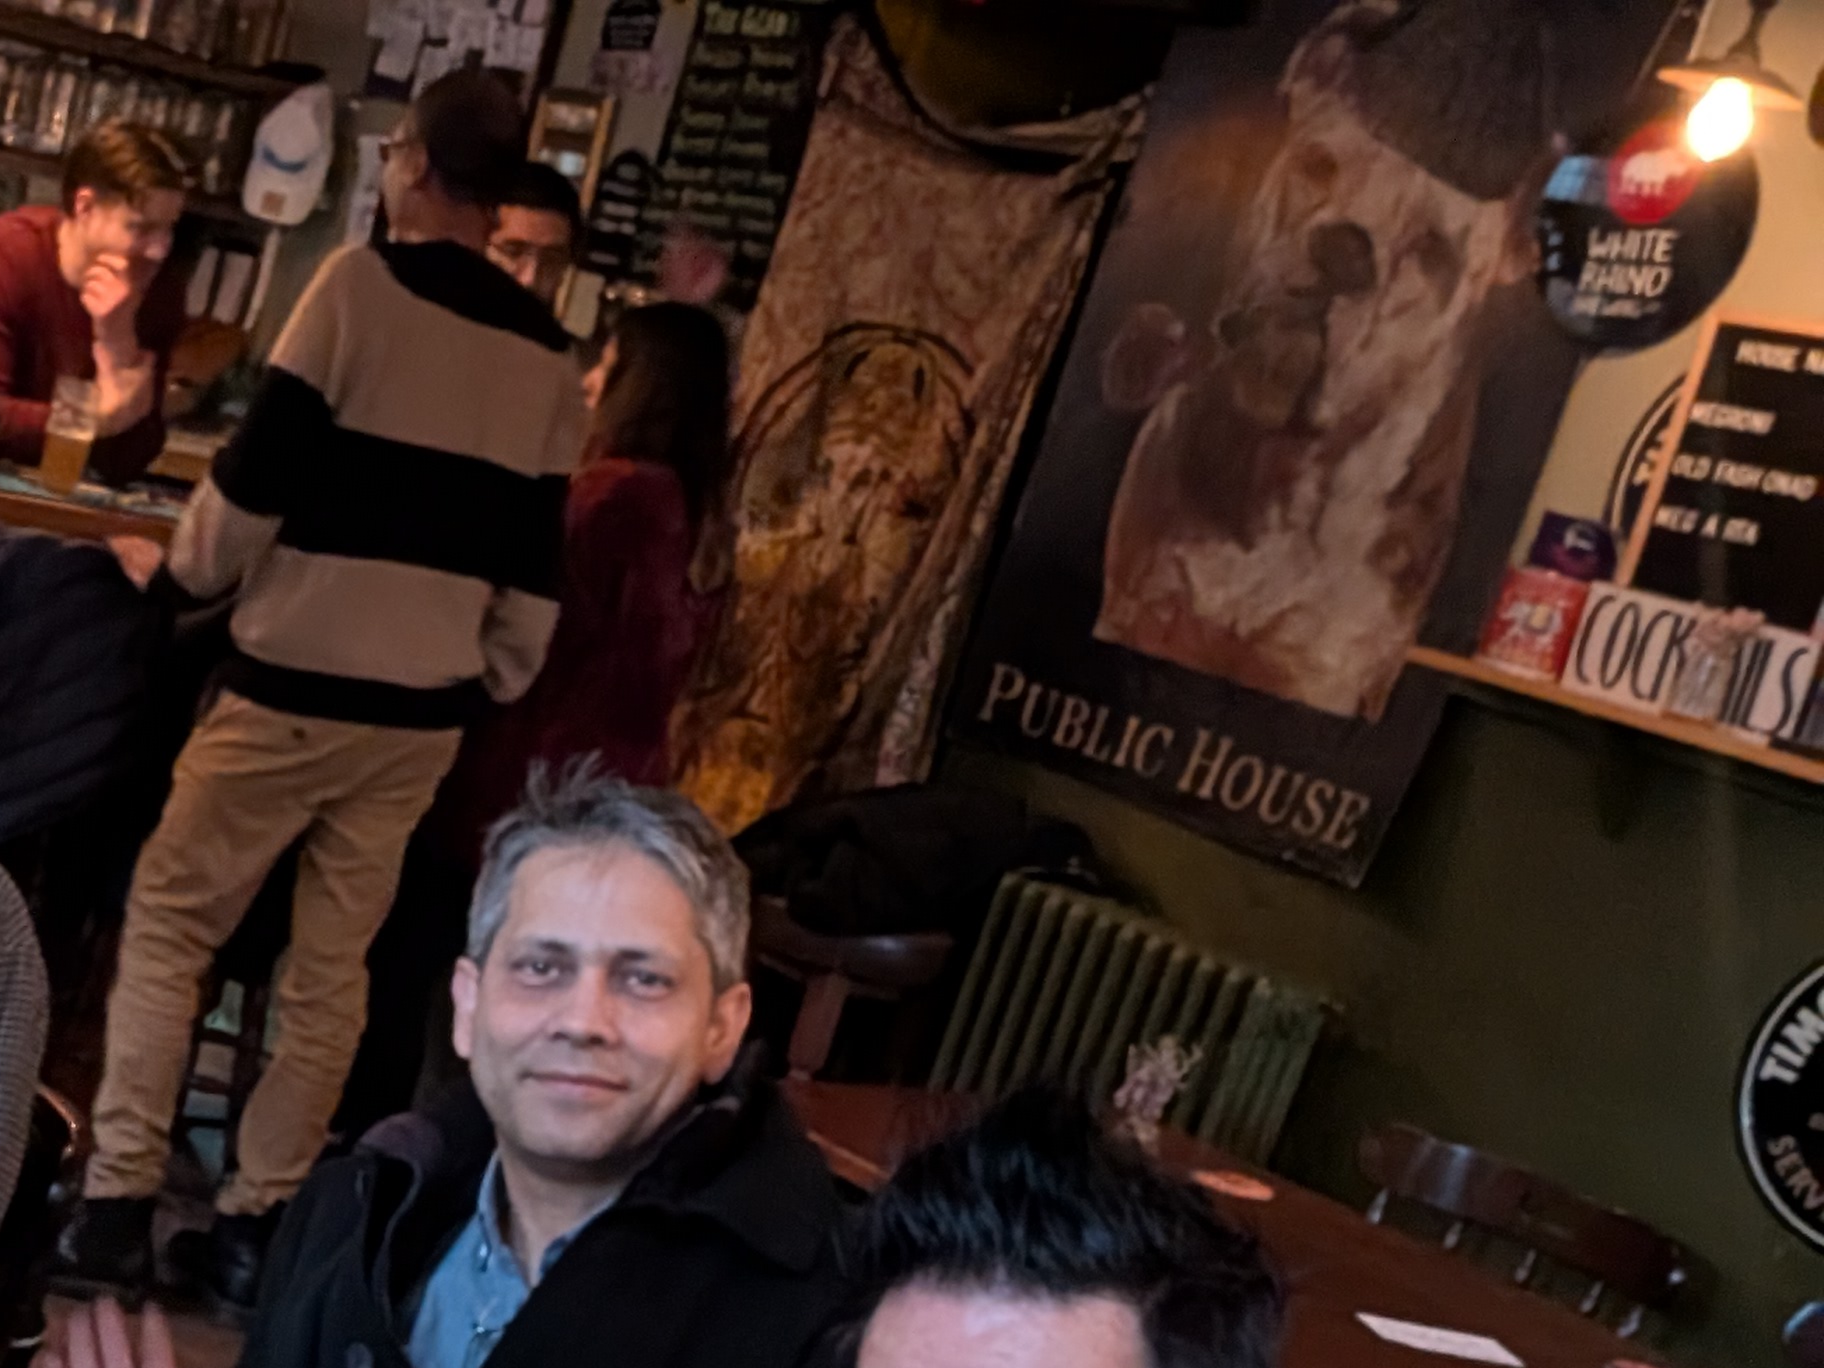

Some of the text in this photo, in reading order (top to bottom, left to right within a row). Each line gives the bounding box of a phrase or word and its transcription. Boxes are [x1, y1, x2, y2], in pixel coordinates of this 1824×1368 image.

[1588, 228, 1679, 262] WHITE
[1578, 260, 1672, 297] RHINO
[1176, 727, 1372, 851] HOUSE
